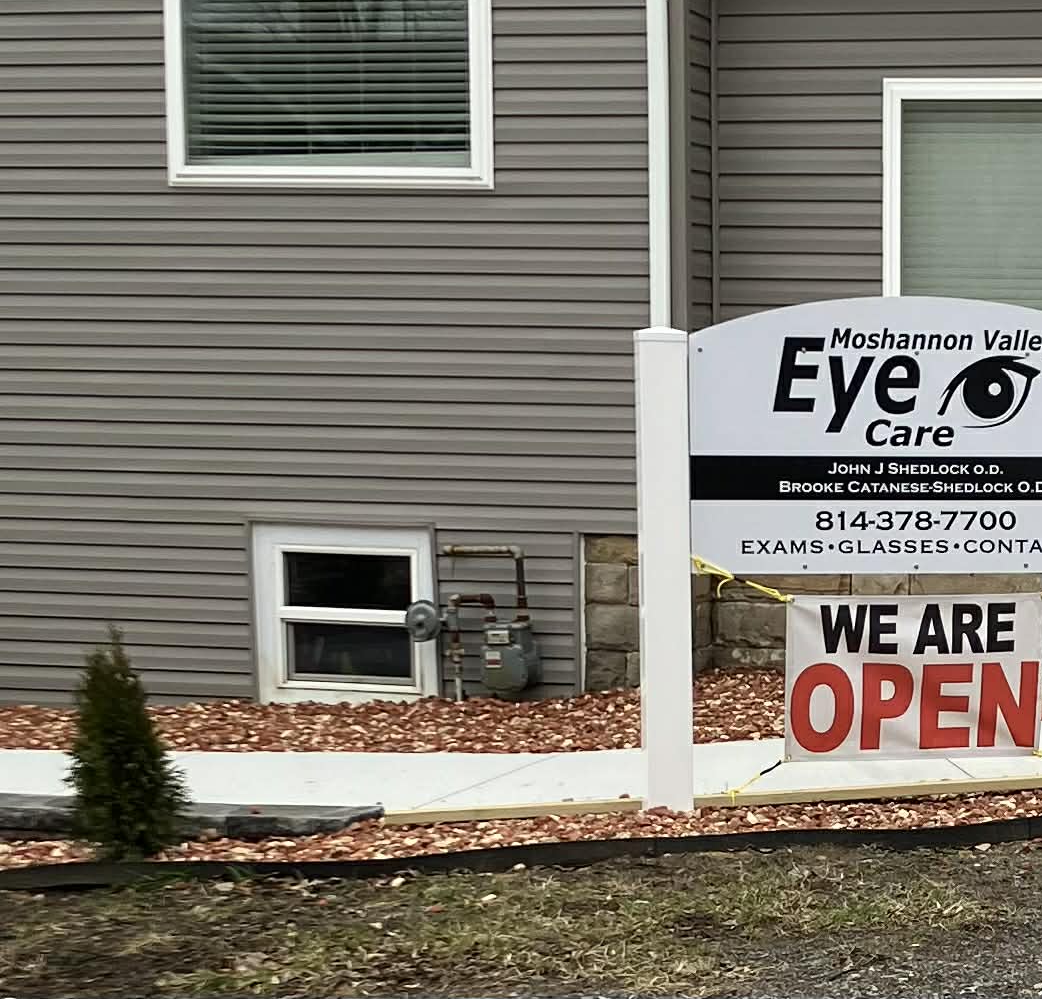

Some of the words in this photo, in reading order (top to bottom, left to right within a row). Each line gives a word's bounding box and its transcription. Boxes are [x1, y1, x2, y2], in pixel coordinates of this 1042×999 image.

[830, 328, 973, 351] Moshannon
[772, 336, 921, 434] Eye
[865, 419, 955, 448] Care
[828, 462, 871, 475] JOHN
[874, 462, 884, 475] J
[888, 462, 970, 475] SHEDLOCK
[779, 481, 844, 493] BROOKE
[815, 511, 1017, 531] 814-378-7700
[820, 604, 898, 654] WE
[912, 602, 1016, 654] ARE
[790, 661, 1039, 753] OPEN
